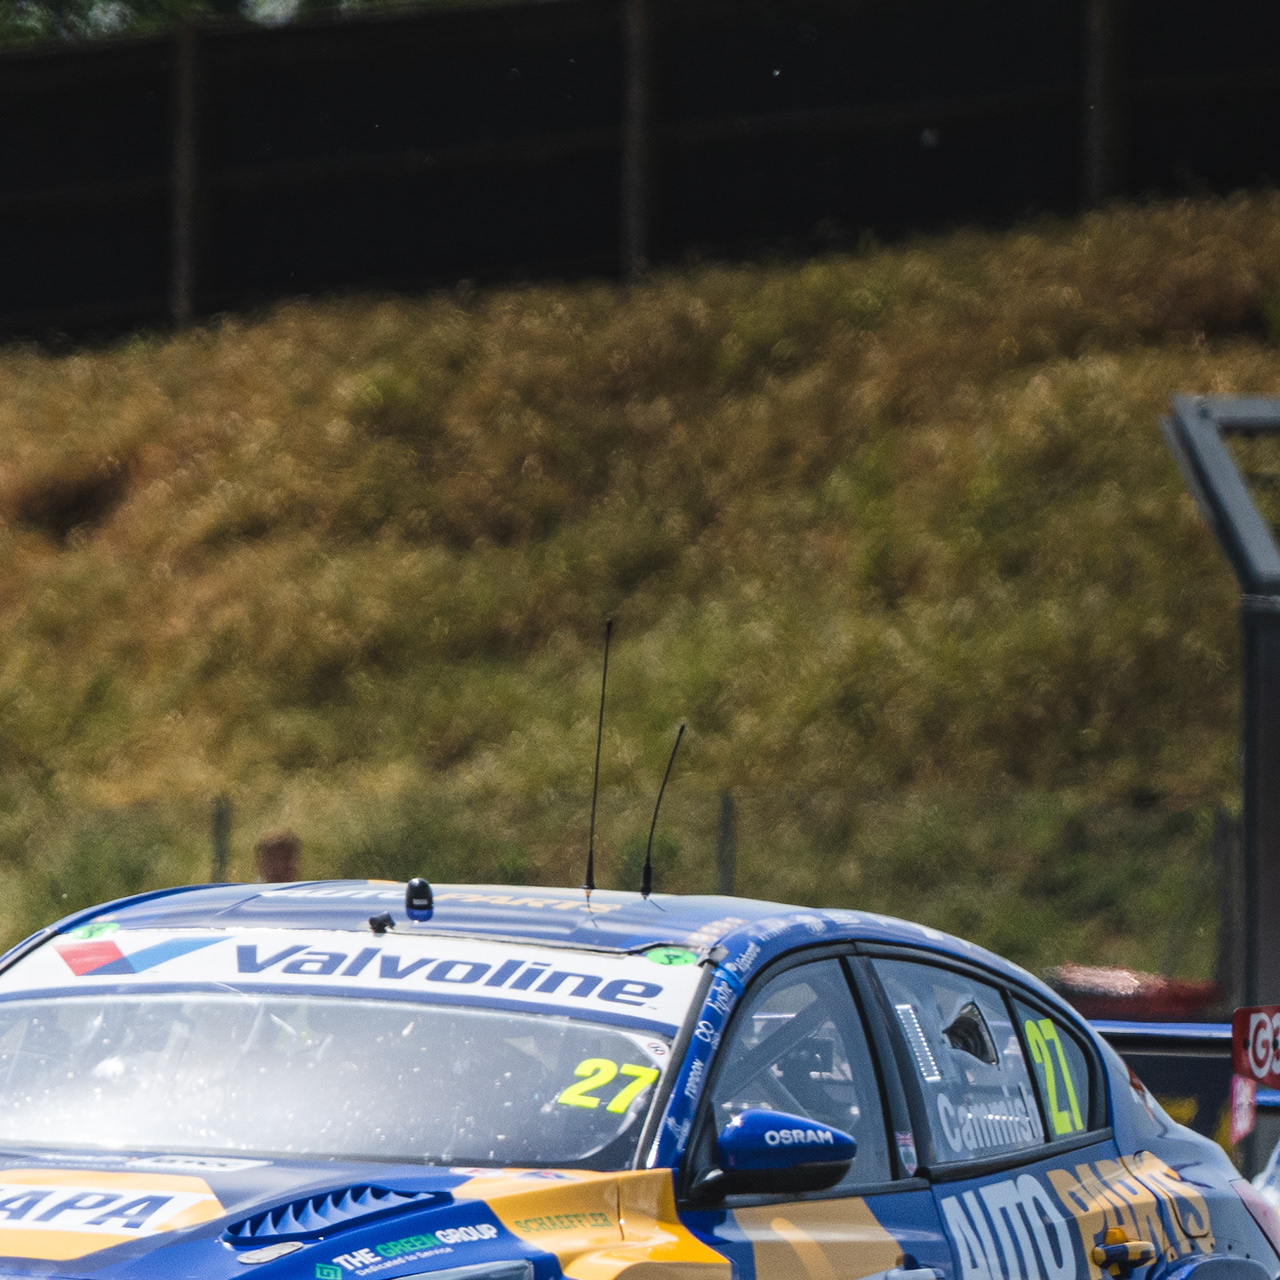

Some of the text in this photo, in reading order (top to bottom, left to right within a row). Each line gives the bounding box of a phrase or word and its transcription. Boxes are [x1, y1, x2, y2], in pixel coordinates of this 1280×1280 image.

[237, 944, 664, 1008] Valvoline
[558, 1058, 660, 1114] 27
[1025, 1018, 1084, 1136] 27
[765, 1130, 835, 1147] OSRAM
[937, 1082, 1046, 1153] Cammish
[332, 1224, 499, 1271] THE GREEN GROUP
[514, 1212, 615, 1233] SCHAEFFLER
